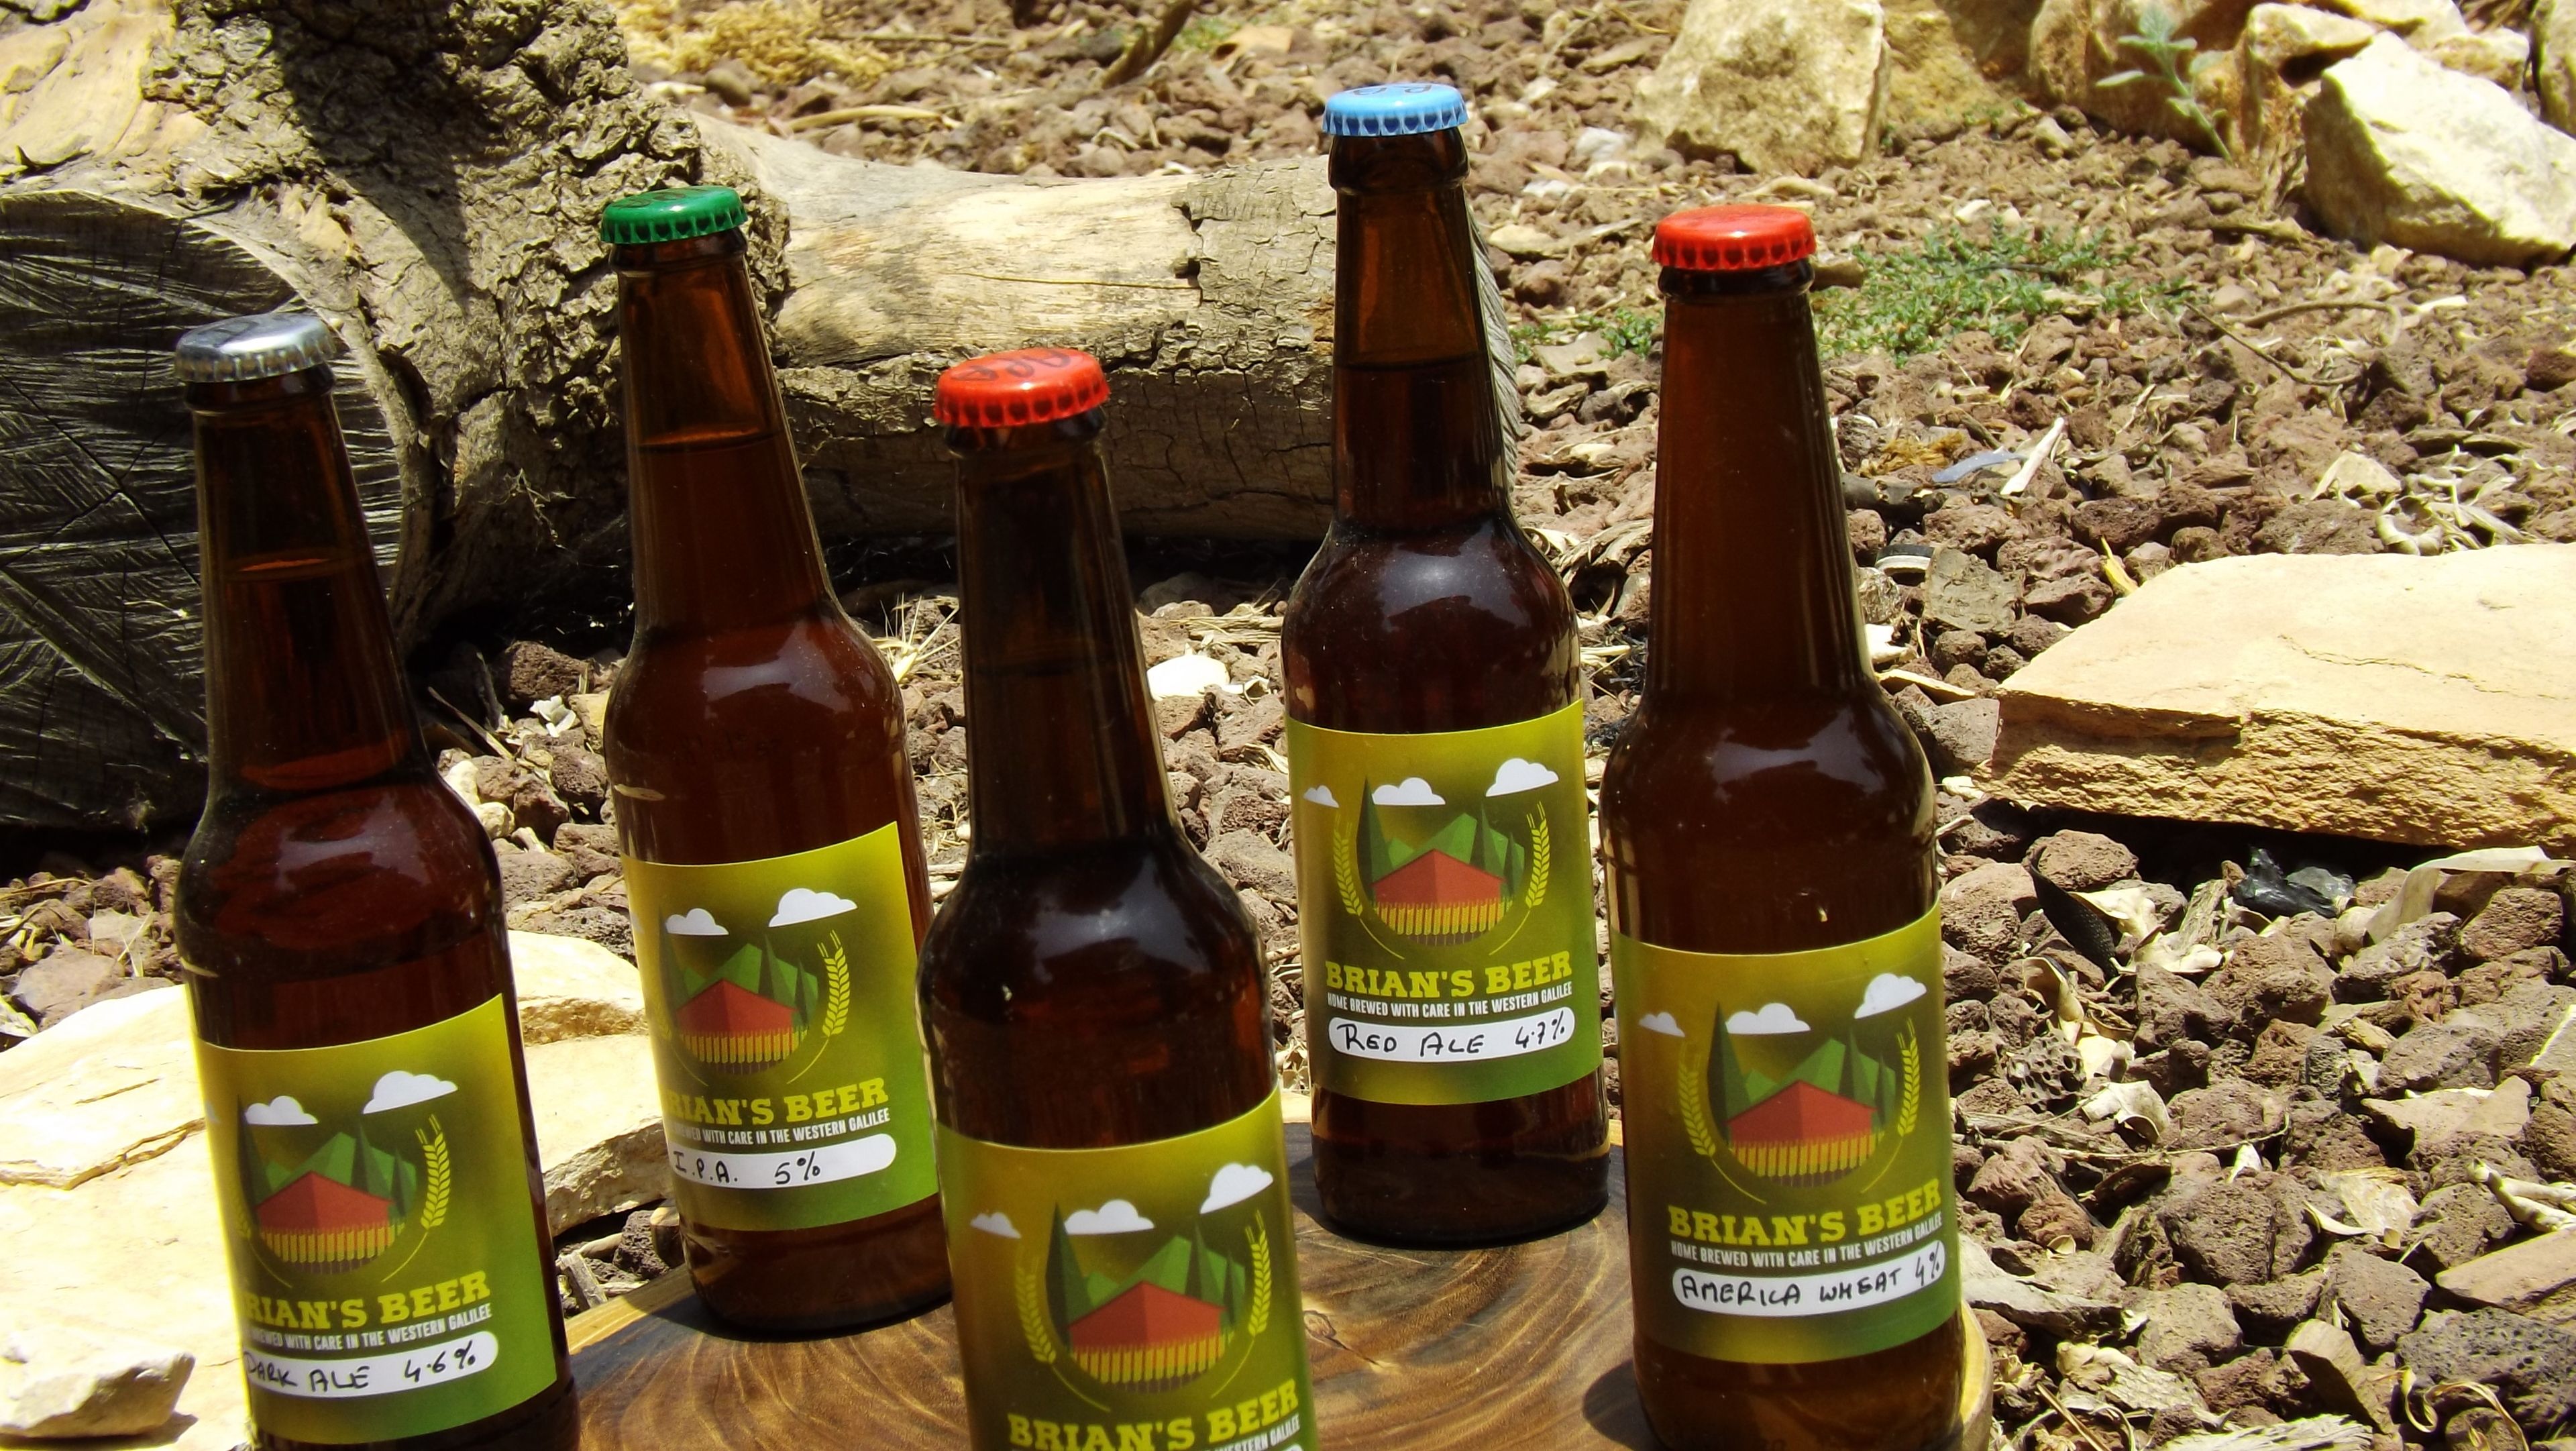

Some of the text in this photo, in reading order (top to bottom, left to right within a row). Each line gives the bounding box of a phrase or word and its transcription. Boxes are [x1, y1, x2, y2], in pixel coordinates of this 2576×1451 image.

[1326, 951, 1572, 998] BRIAN'S BEER
[1328, 981, 1572, 1018] HOME BREWED WITH CARE IN THE WESTERN GALILEE
[1420, 1032, 1484, 1057] ALE
[667, 1077, 889, 1125] RIAN'S BEER
[702, 1129, 726, 1144] WITH
[728, 1131, 753, 1144] CARE
[756, 1130, 767, 1144] IN
[769, 1129, 791, 1143] THE
[793, 1120, 847, 1142] WESTERN
[849, 1108, 890, 1132] GALILEE
[674, 1150, 820, 1184] I.P.A. 5%
[1668, 1178, 1941, 1246] BRIAN'S BEER
[1671, 1211, 1942, 1267] HOME BREWED WITH CARE IN THE WESTERN GALILEE
[1680, 1241, 1940, 1306] AMERICA WHEAT 4%
[243, 1271, 490, 1329] RIAN'S BEER
[285, 1332, 312, 1350] WITH
[313, 1334, 343, 1350] CARE
[345, 1334, 359, 1348] IN
[362, 1331, 385, 1347] THE
[387, 1318, 446, 1344] WESTERN
[448, 1303, 492, 1330] GALILEE
[243, 1350, 298, 1387] DARK
[310, 1364, 370, 1393] ALE
[1008, 1379, 1299, 1451] BRIAN'S BEER
[1270, 1413, 1300, 1446] GALILEE
